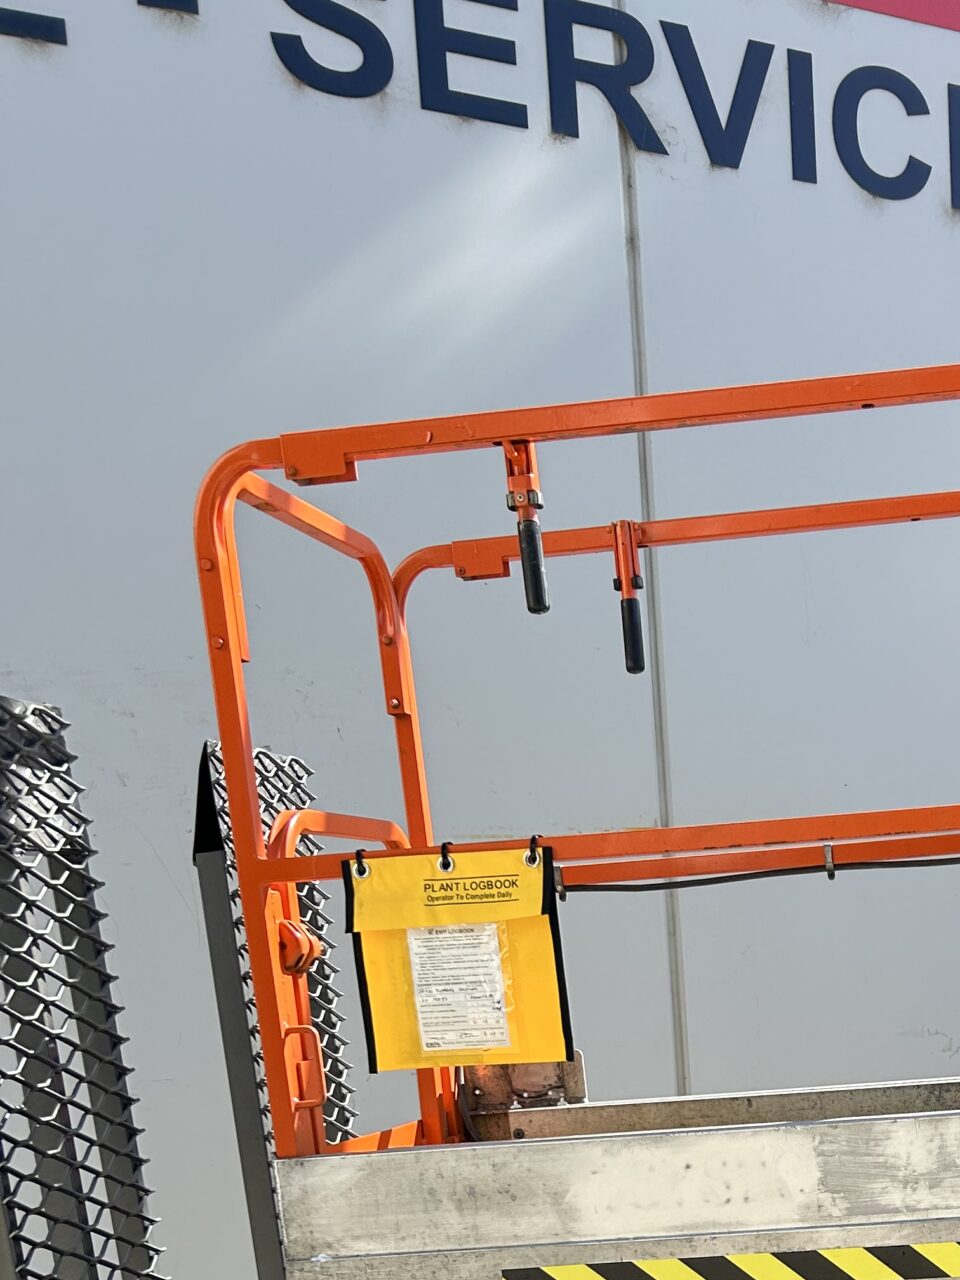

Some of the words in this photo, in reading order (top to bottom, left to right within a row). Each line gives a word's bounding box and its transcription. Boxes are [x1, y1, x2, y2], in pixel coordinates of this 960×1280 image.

[424, 882, 461, 892] PLANT
[463, 879, 519, 891] LOGBOOK
[427, 893, 454, 902] Operator
[465, 892, 495, 901] Complete
[497, 891, 512, 899] Daily
